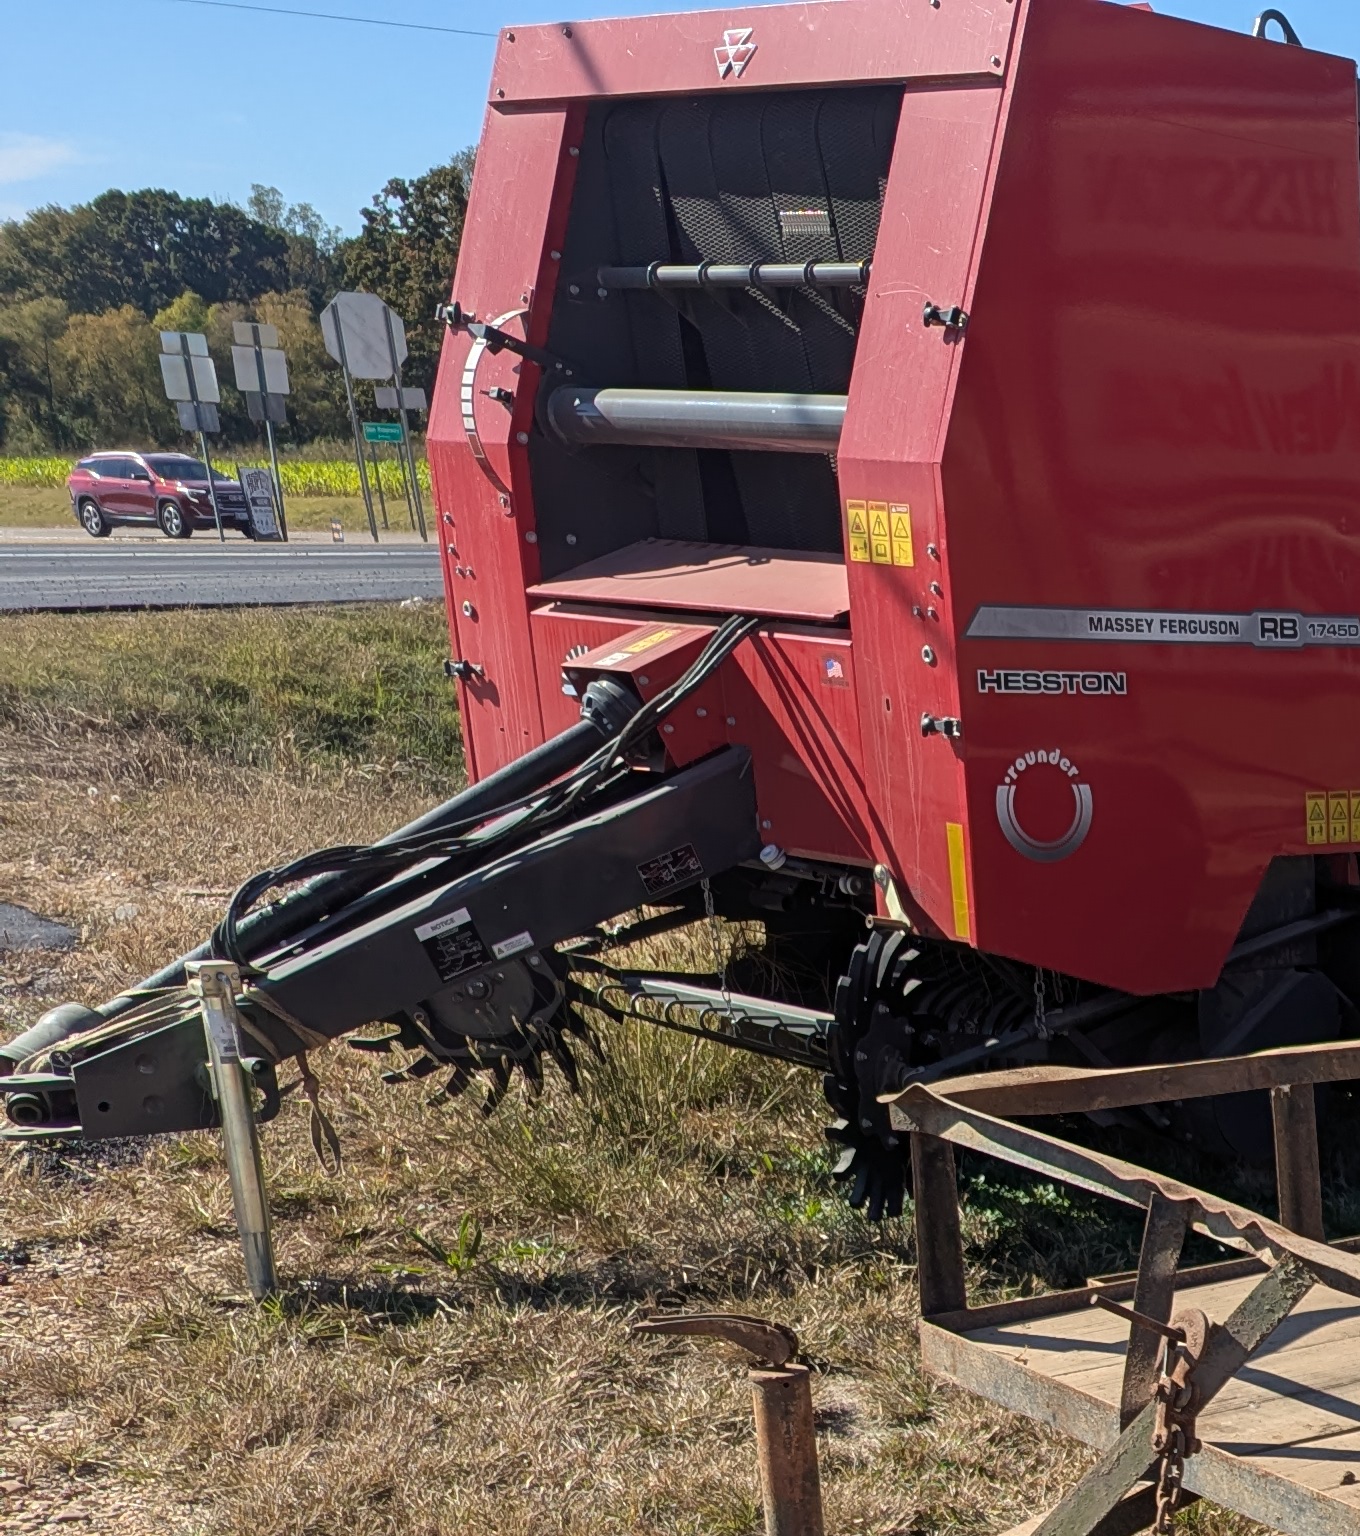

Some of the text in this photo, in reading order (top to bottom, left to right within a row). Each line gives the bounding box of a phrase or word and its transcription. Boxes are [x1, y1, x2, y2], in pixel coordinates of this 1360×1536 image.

[1088, 616, 1154, 634] MASSEY
[1159, 618, 1240, 636] FERGUSON
[1259, 617, 1299, 640] RB
[978, 670, 1127, 694] HESSTON
